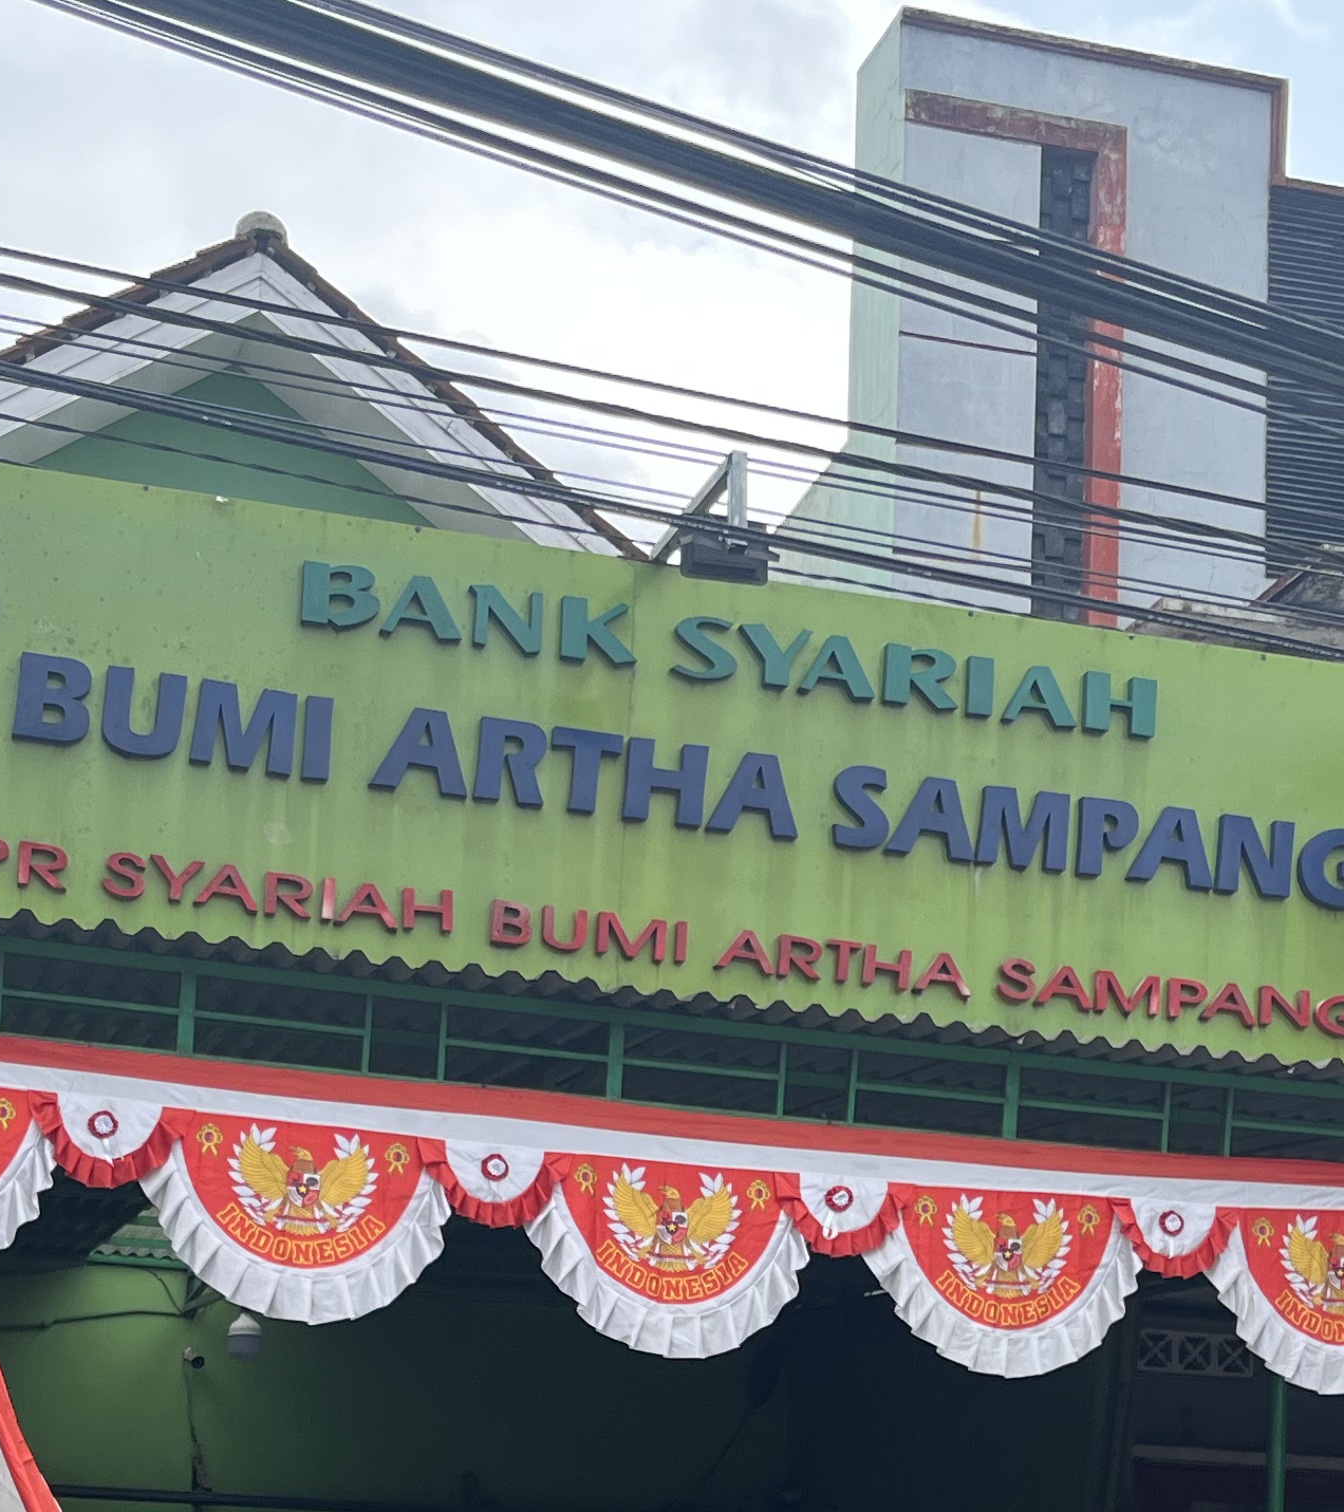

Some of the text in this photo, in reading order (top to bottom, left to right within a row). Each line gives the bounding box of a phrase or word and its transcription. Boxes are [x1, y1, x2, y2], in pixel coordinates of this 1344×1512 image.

[300, 559, 1159, 740] BANK SYARIAH
[10, 650, 335, 784] BUMI
[367, 706, 799, 842] ARTHA
[101, 851, 455, 934] SYARIAH
[489, 897, 689, 966] BUMI
[712, 929, 971, 1000] ARTHA
[216, 1200, 386, 1266] INDONESIA
[592, 1239, 750, 1302] INDONESIA
[934, 1269, 1085, 1331] INDONESIA
